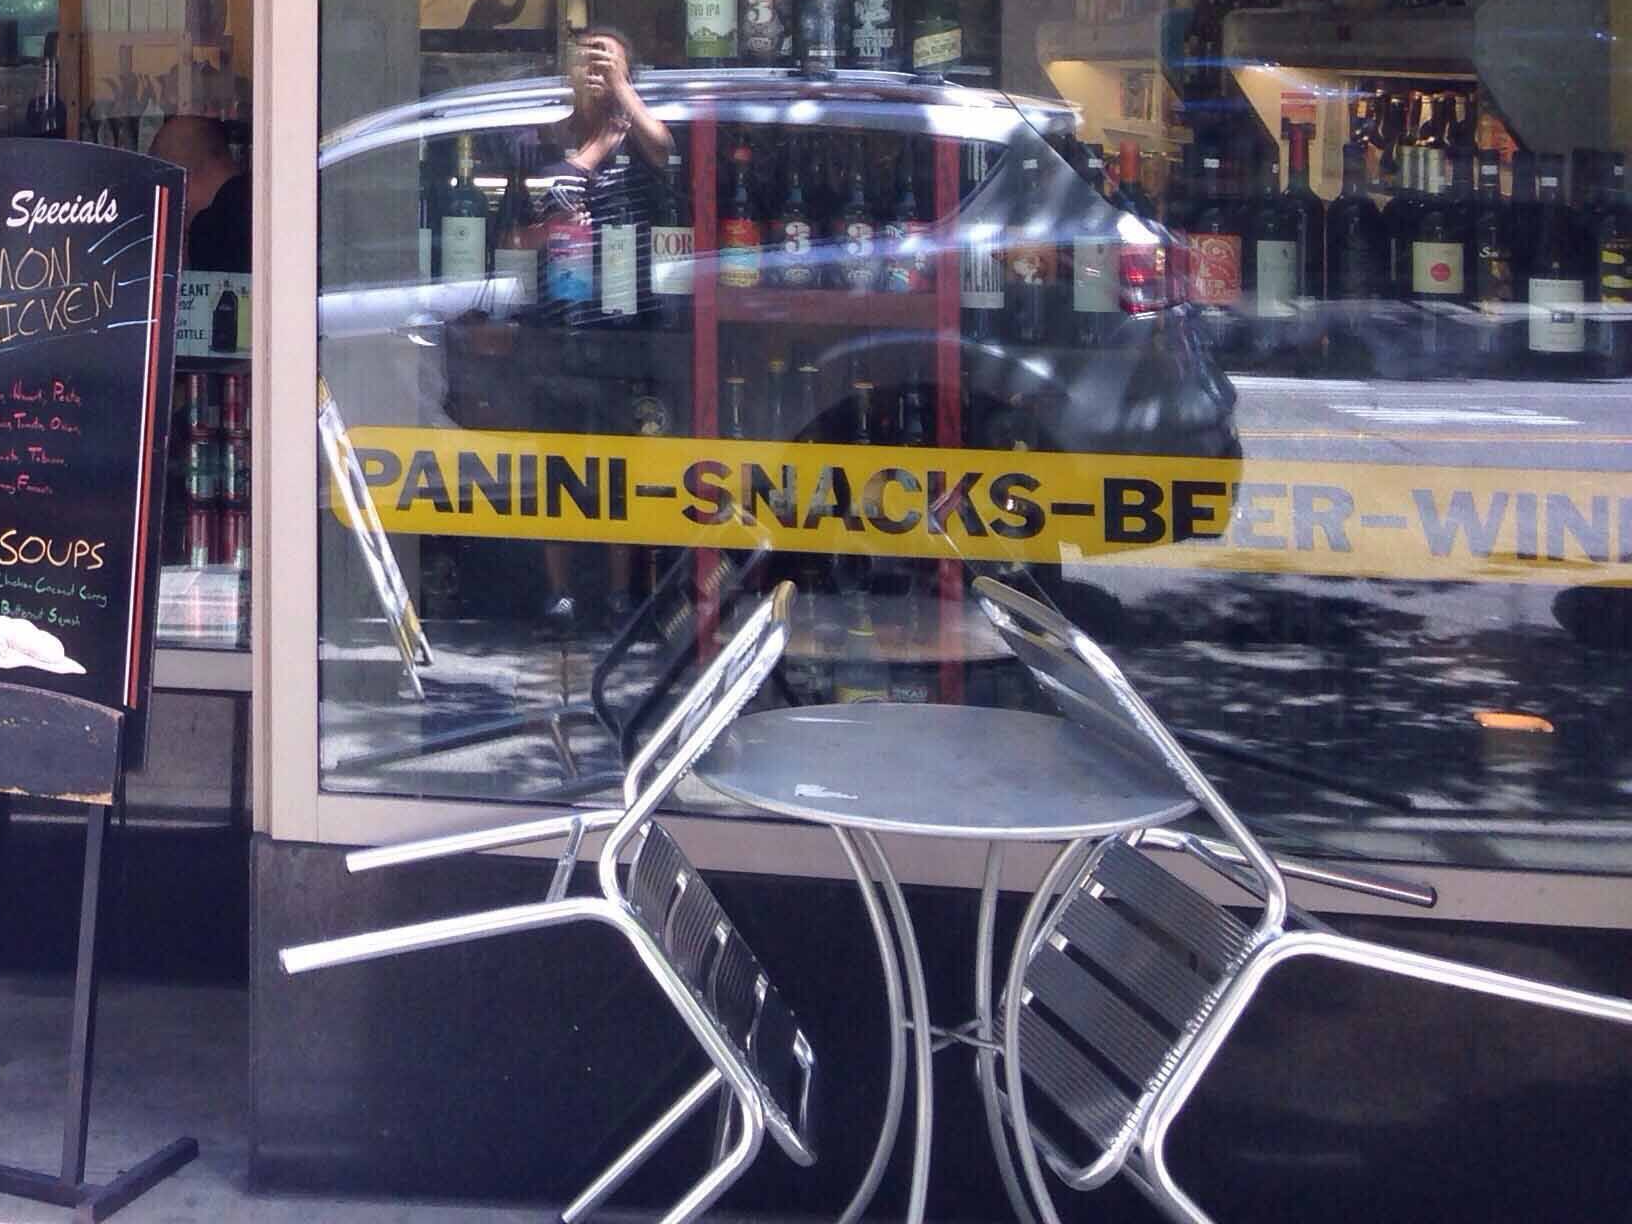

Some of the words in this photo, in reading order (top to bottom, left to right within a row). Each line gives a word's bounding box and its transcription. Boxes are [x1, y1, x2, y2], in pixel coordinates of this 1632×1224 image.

[6, 187, 120, 234] Specials
[356, 447, 1632, 564] PANINI-SNACKS-BEER-WIN
[0, 529, 106, 571] SOUPS
